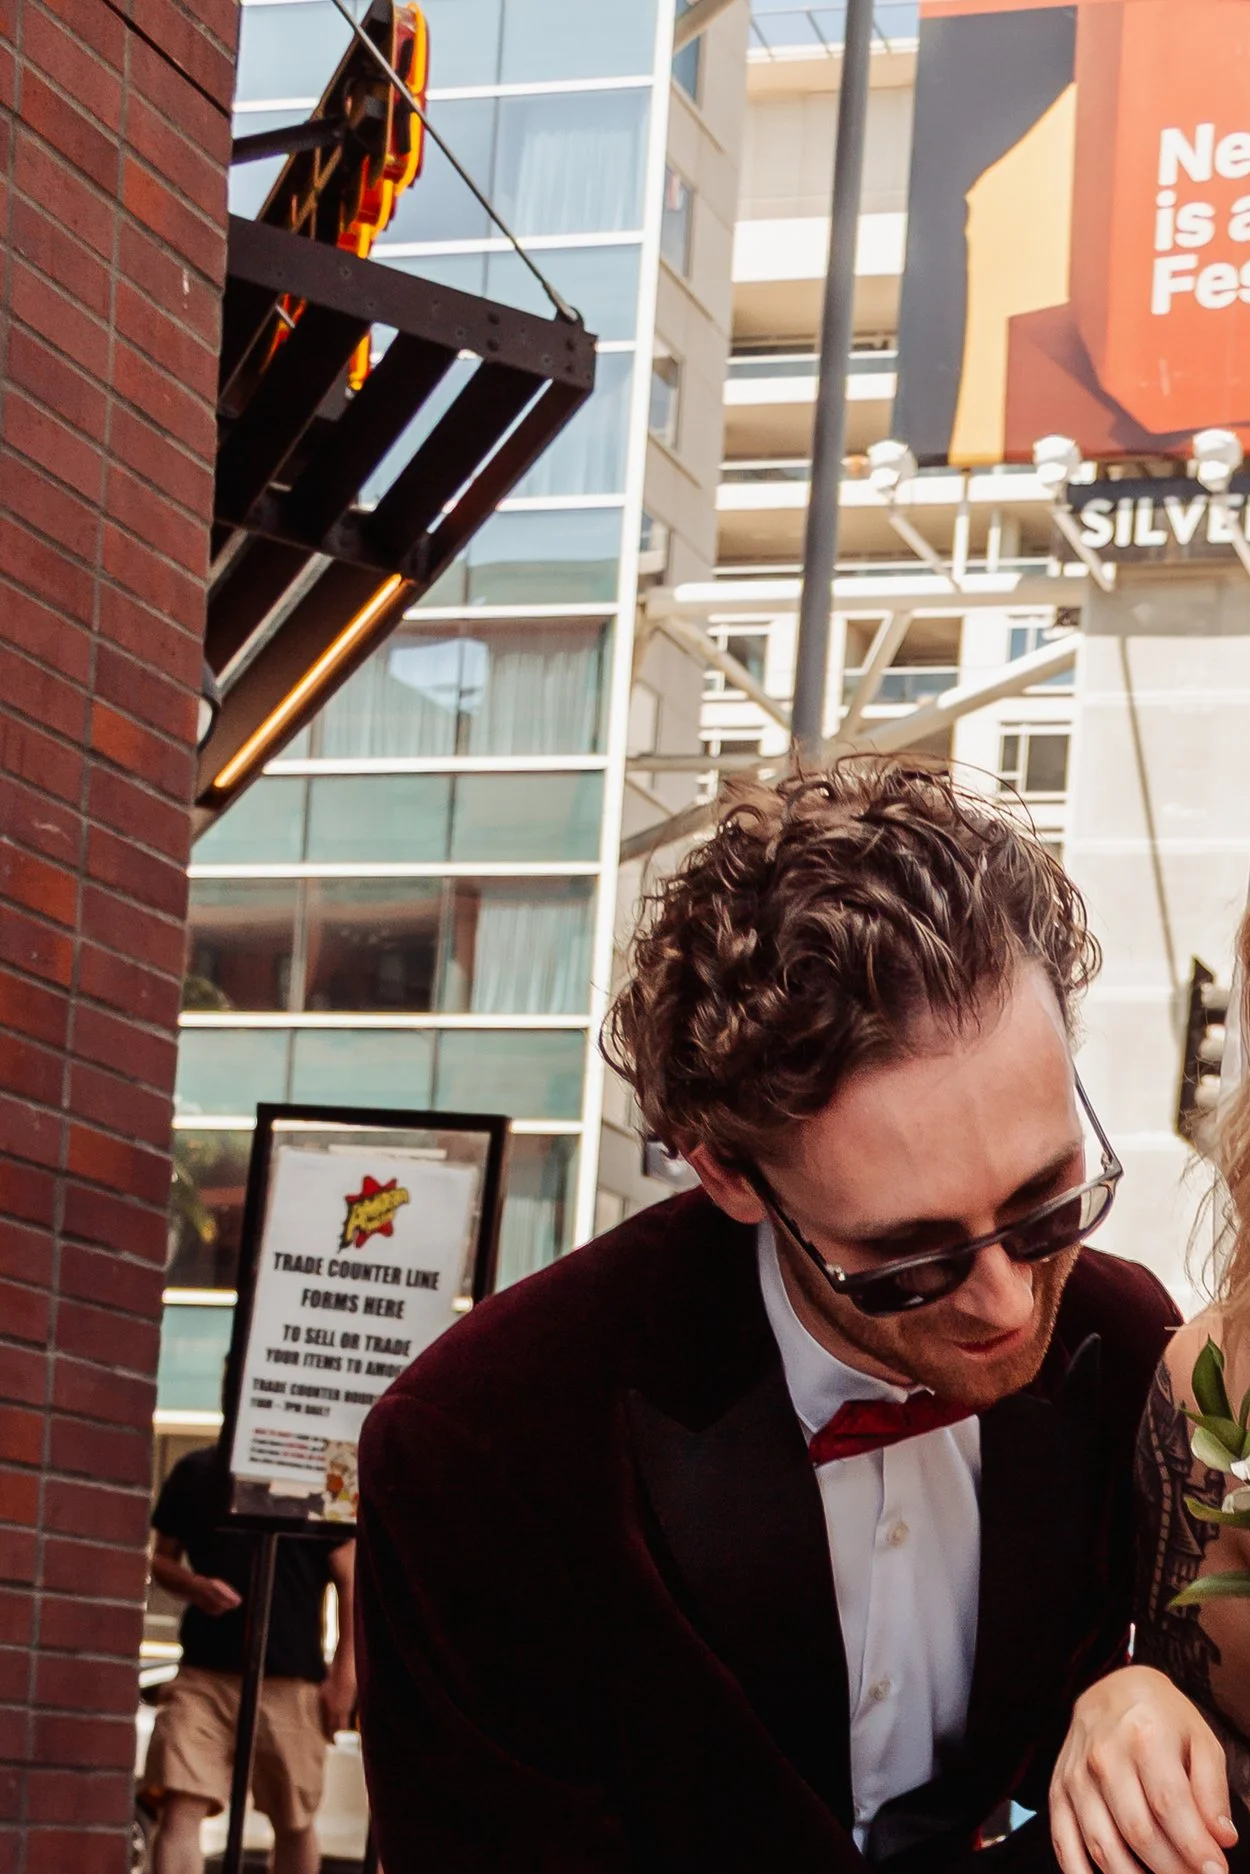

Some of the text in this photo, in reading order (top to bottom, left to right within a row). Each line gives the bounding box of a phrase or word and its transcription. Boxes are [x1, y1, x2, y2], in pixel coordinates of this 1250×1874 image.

[1155, 191, 1214, 250] is
[273, 1252, 440, 1290] TRADE COUNTER LINE
[301, 1288, 405, 1319] FORMS HERE
[283, 1325, 411, 1356] TO SELL OR TRADE
[267, 1349, 299, 1365] YOUR
[303, 1353, 342, 1371] ITEMS
